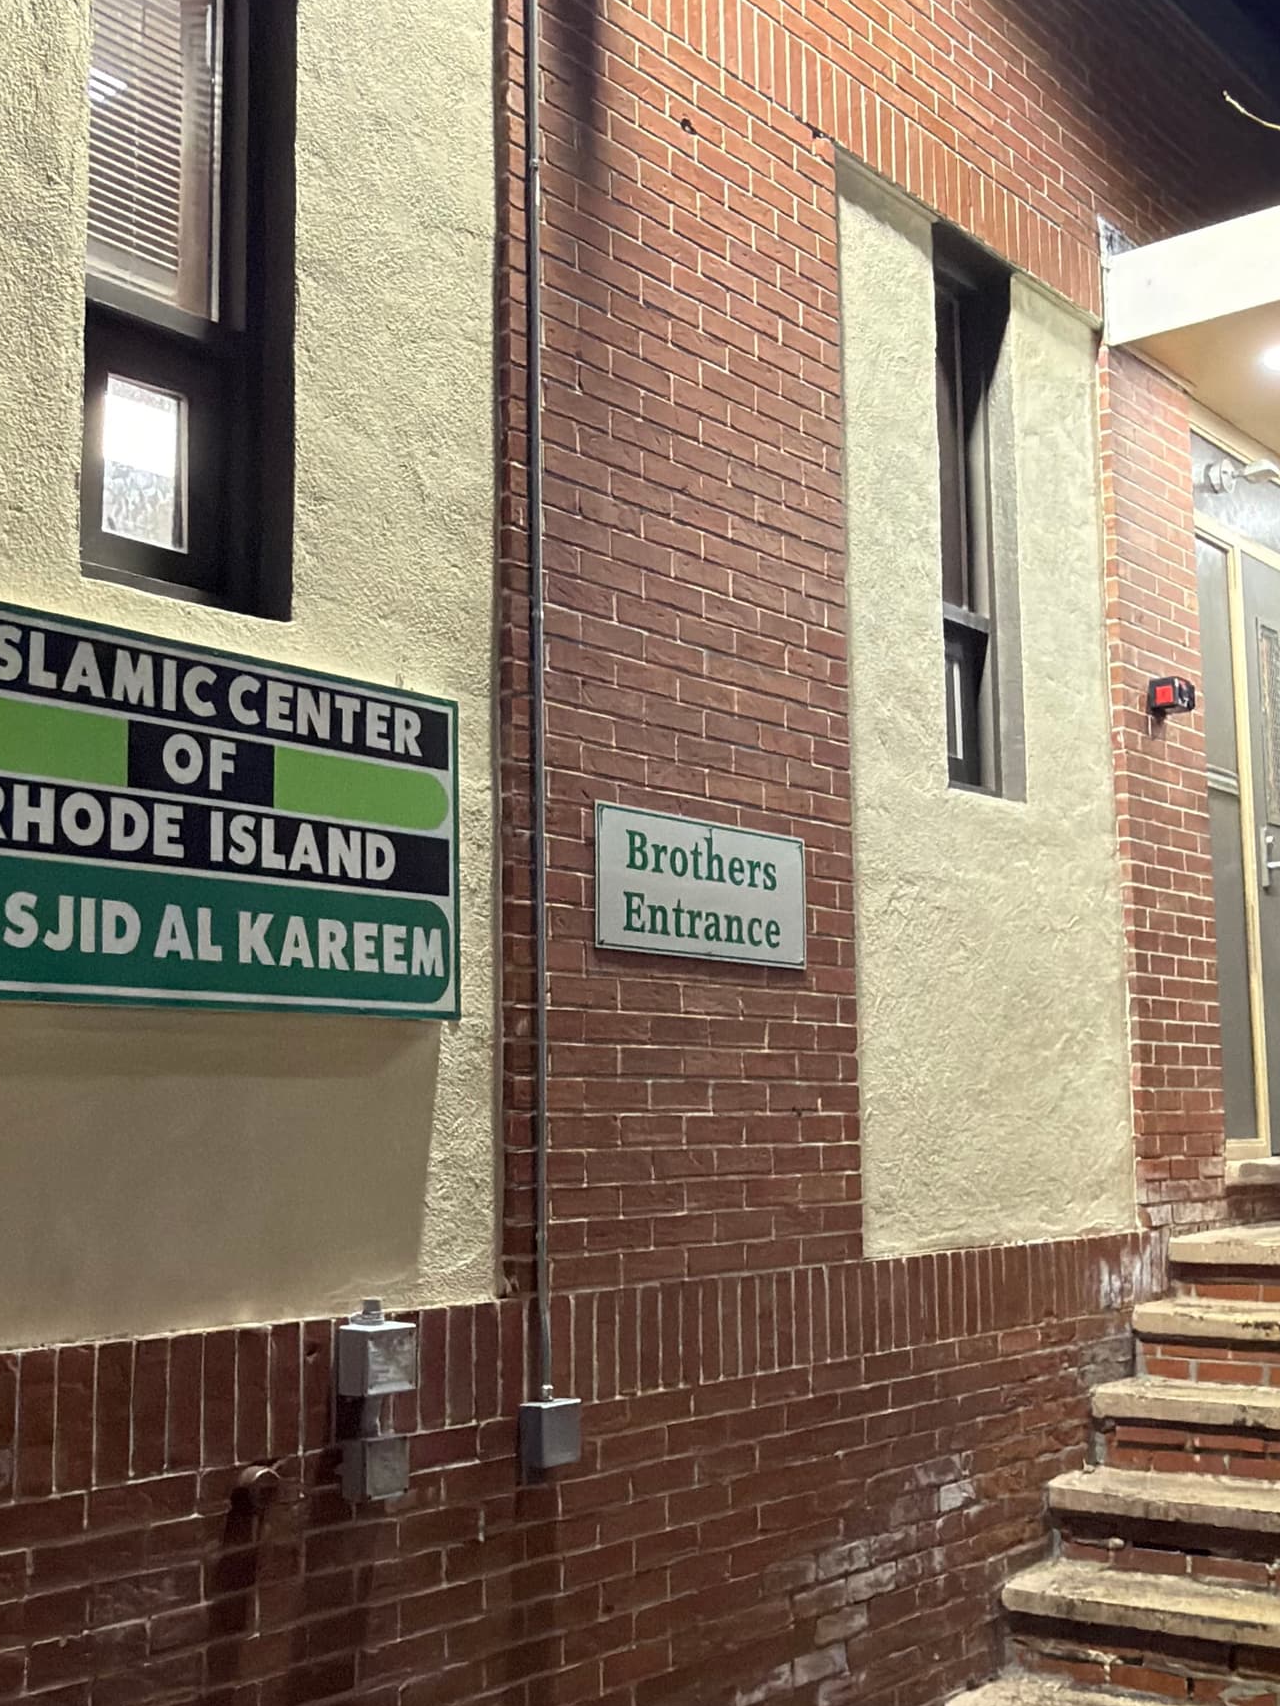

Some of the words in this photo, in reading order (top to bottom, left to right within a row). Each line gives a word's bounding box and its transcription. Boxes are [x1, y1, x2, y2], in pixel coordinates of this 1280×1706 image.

[229, 674, 423, 757] CENTER
[162, 733, 237, 791] OF
[210, 810, 397, 880] ISLAND
[626, 829, 777, 891] Brothers
[154, 903, 222, 962] AL
[238, 910, 444, 978] KAREEM
[623, 891, 781, 948] Entrance
